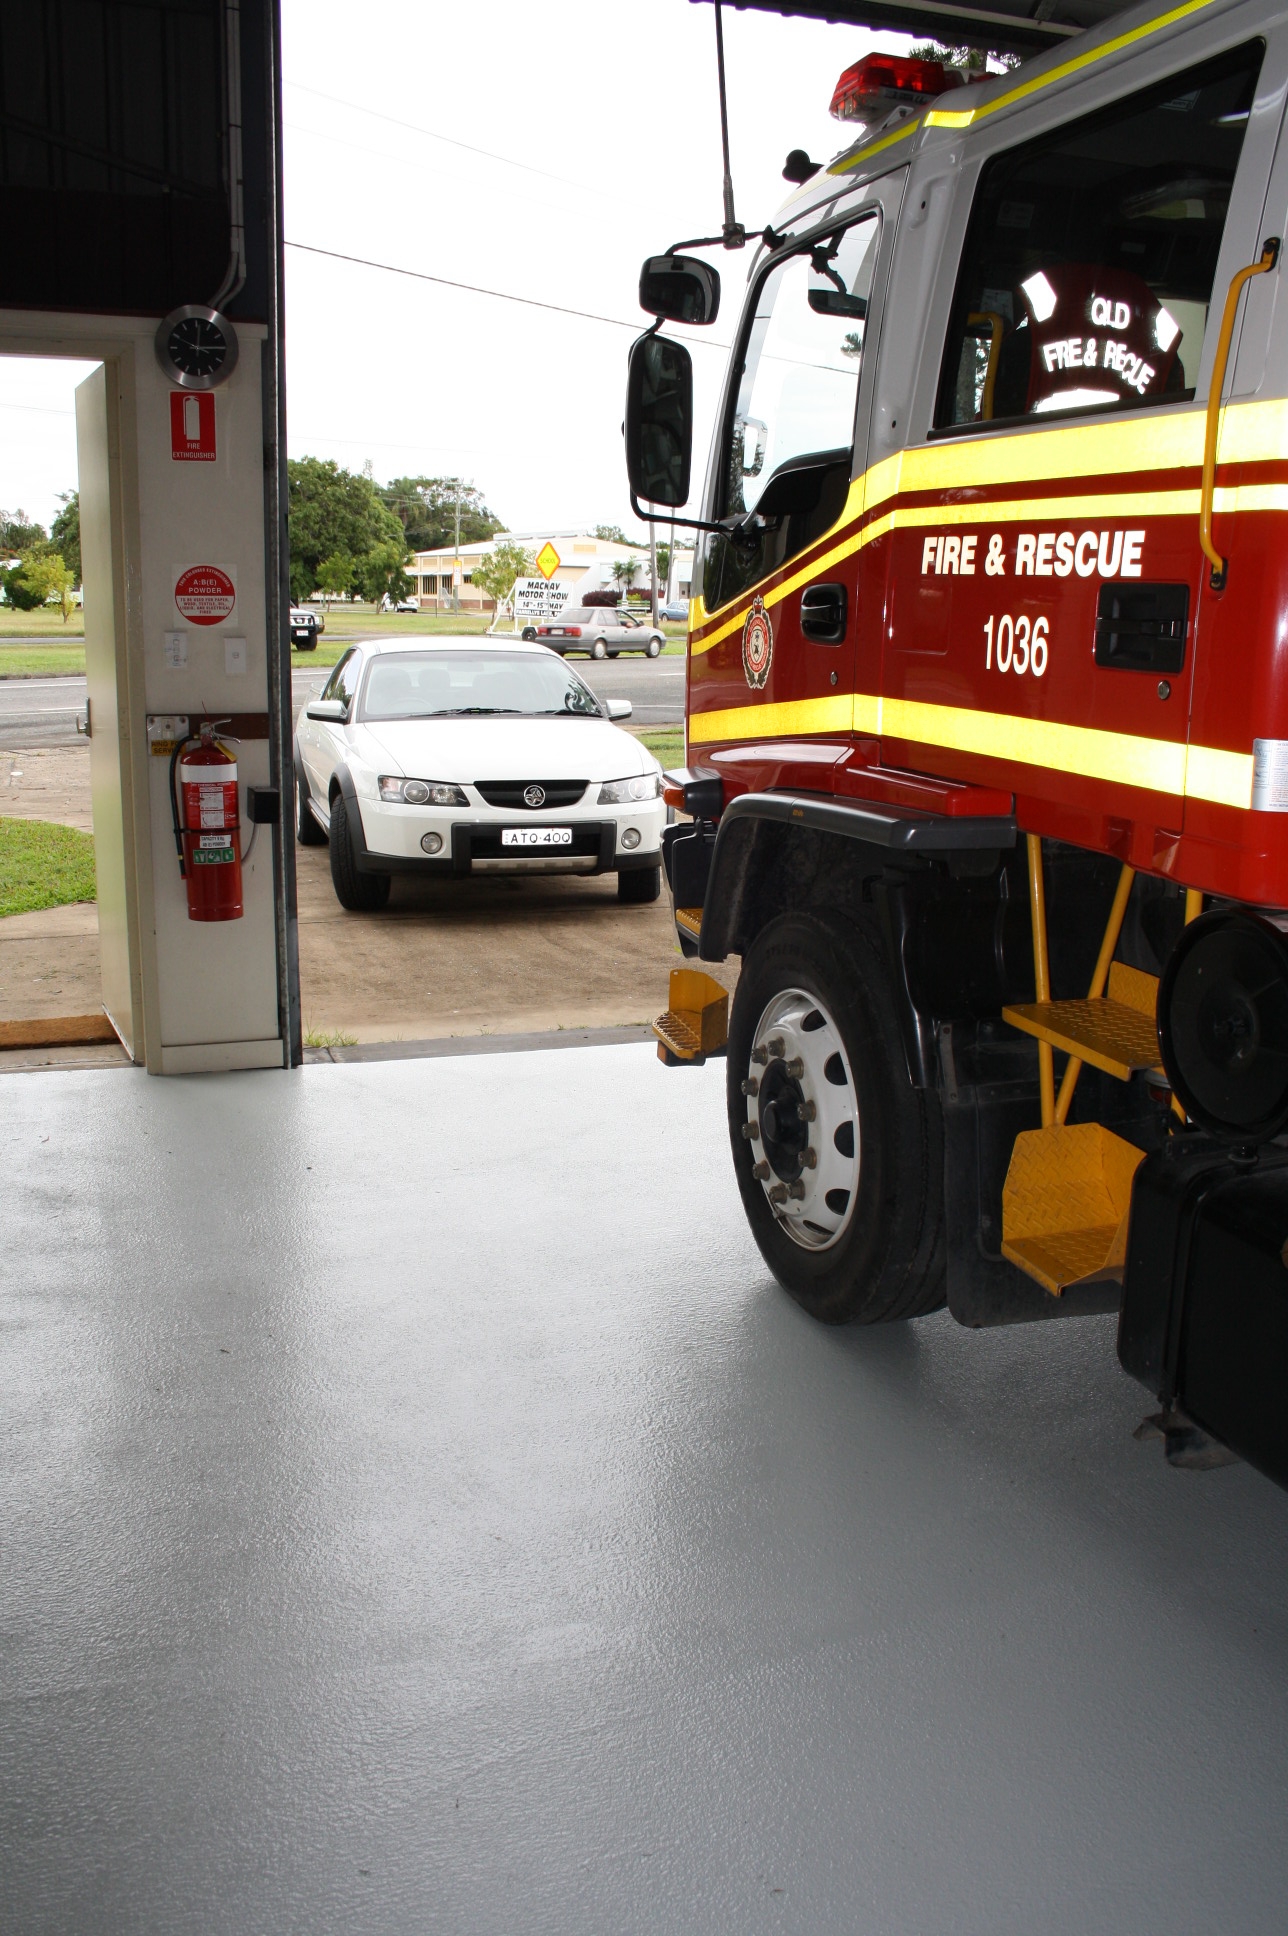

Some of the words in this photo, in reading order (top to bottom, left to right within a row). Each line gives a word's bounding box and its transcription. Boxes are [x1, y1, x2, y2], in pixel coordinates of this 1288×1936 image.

[1091, 297, 1131, 330] QLD
[1083, 338, 1098, 367] &
[186, 442, 201, 450] FIRE
[172, 451, 216, 459] EXTINGUISHER
[920, 535, 978, 576] FIRE
[984, 533, 1007, 577] &
[1014, 529, 1146, 578] RESCUE
[526, 581, 561, 591] MACKAY
[518, 590, 544, 599] MOTOR
[546, 592, 569, 601] SHOW
[549, 602, 564, 610] MAY
[983, 613, 1050, 677] 1036
